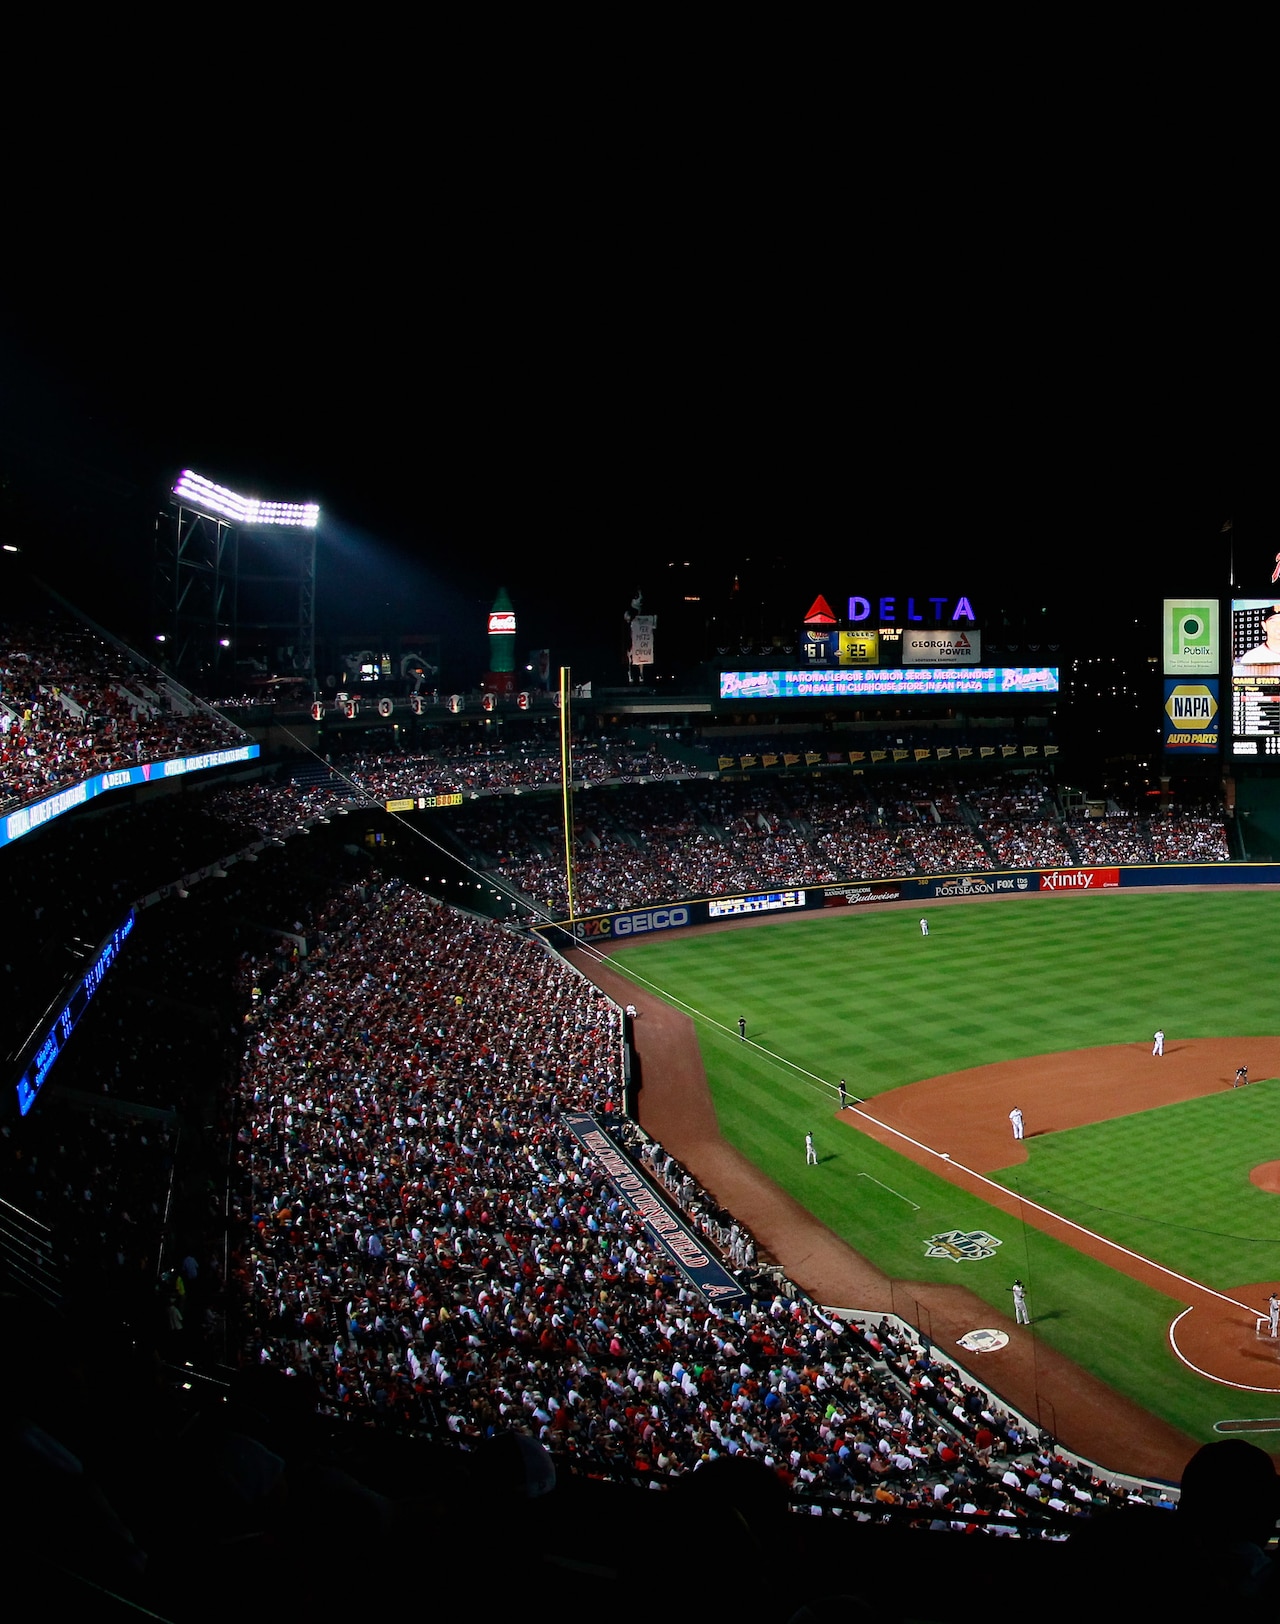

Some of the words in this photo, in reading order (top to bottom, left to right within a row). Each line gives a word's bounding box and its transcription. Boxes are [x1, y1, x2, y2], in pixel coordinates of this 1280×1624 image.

[848, 597, 976, 621] DELTA
[1184, 646, 1211, 655] Publix
[785, 674, 829, 683] NATIONAL
[831, 673, 863, 682] LEAGUE
[865, 672, 903, 681] DIVISION
[905, 671, 932, 680] SERIES
[933, 670, 995, 680] MERCHANDISE
[797, 684, 812, 693] ON
[814, 683, 835, 693] SALE
[836, 683, 846, 692] IN
[847, 682, 897, 692] CLUBHOUSE
[899, 681, 924, 690] STORE
[926, 681, 935, 690] IN
[937, 681, 954, 689] FAN
[956, 681, 983, 689] PLAZA
[1175, 698, 1210, 717] NAPA
[1167, 733, 1191, 744] AUTO
[1191, 733, 1218, 744] PARTS
[109, 771, 131, 787] DELTA
[997, 879, 1014, 889] FOX
[1042, 871, 1094, 890] xfinity
[935, 883, 994, 896] POSTSEASON
[846, 892, 900, 904] Budweiser
[614, 908, 688, 935] GEICO
[581, 1130, 632, 1176] WELCOME
[615, 1174, 643, 1189] TO
[626, 1188, 678, 1234] TURNER
[662, 1230, 709, 1268] FIELD
